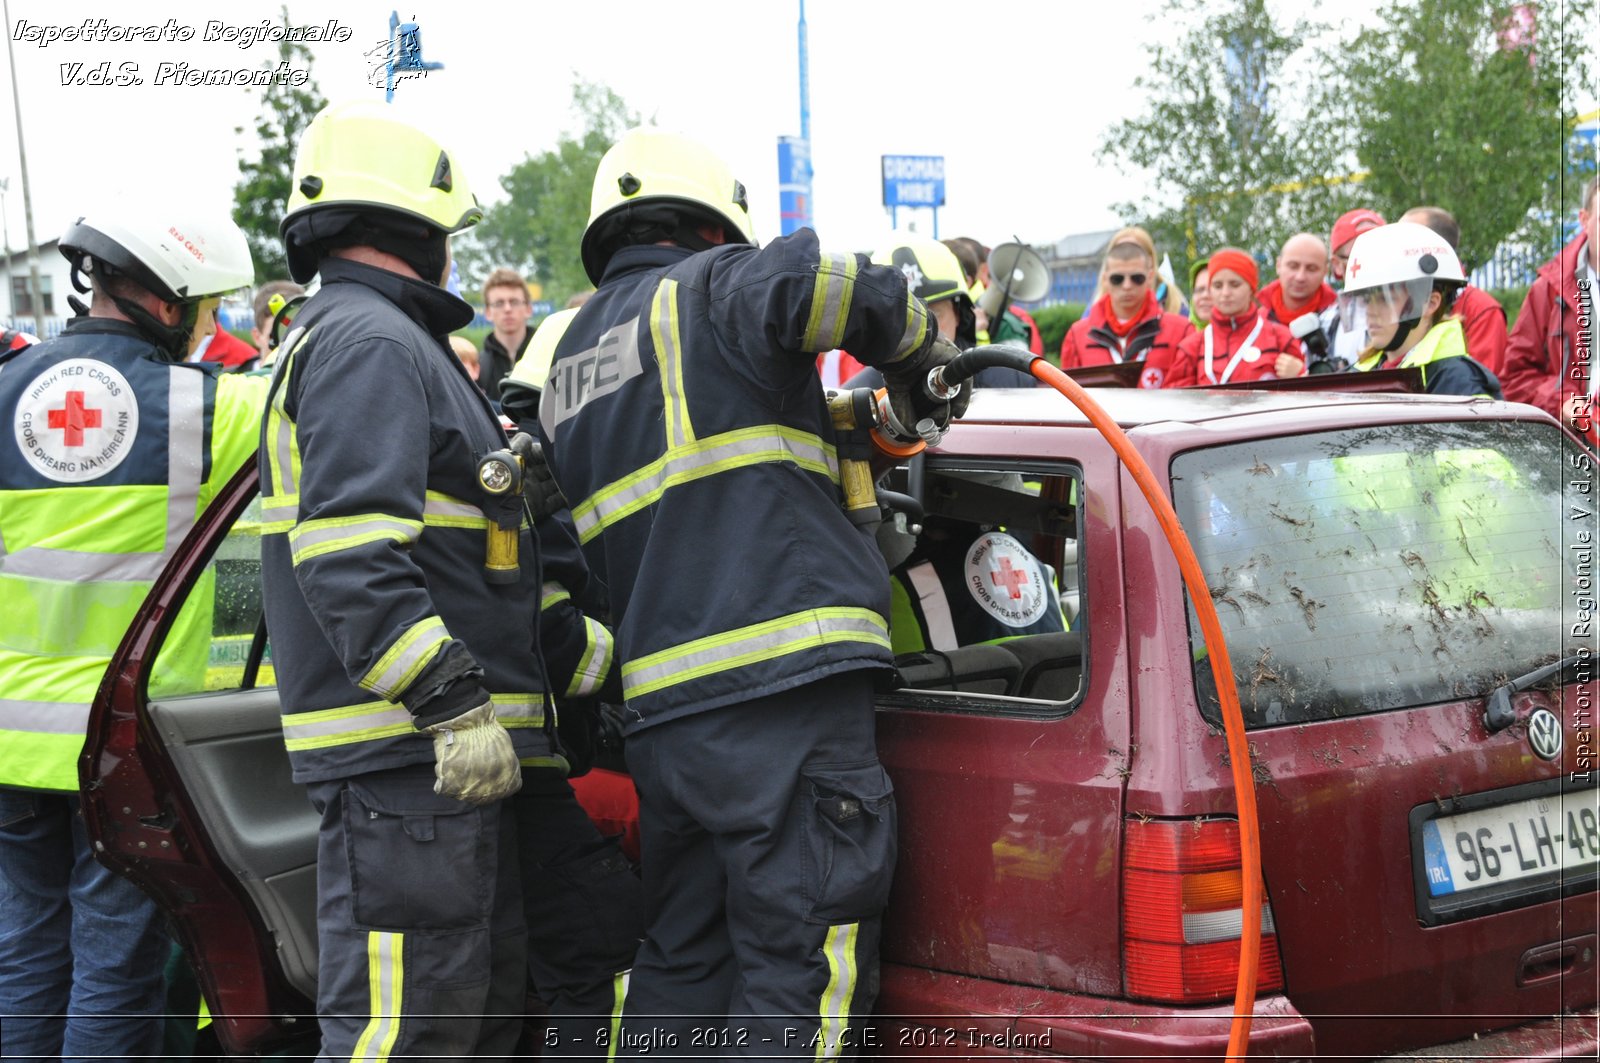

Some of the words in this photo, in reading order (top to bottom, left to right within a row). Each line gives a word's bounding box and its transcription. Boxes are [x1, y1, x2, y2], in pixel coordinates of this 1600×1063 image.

[896, 181, 935, 202] HIRE
[168, 226, 184, 242] RED
[184, 240, 206, 264] CROSS
[32, 375, 58, 400] IRISH
[60, 366, 84, 377] RED
[88, 368, 121, 397] CROSS
[22, 412, 38, 449] CROIS
[33, 447, 76, 472] DHEARG
[79, 459, 97, 472] NA
[972, 545, 987, 566] IRISH
[1003, 539, 1030, 561] CROSS
[972, 575, 992, 602] CROIS
[990, 602, 1022, 620] DHEARG
[1455, 805, 1600, 882] 96-LH-48
[1428, 866, 1449, 885] IRL
